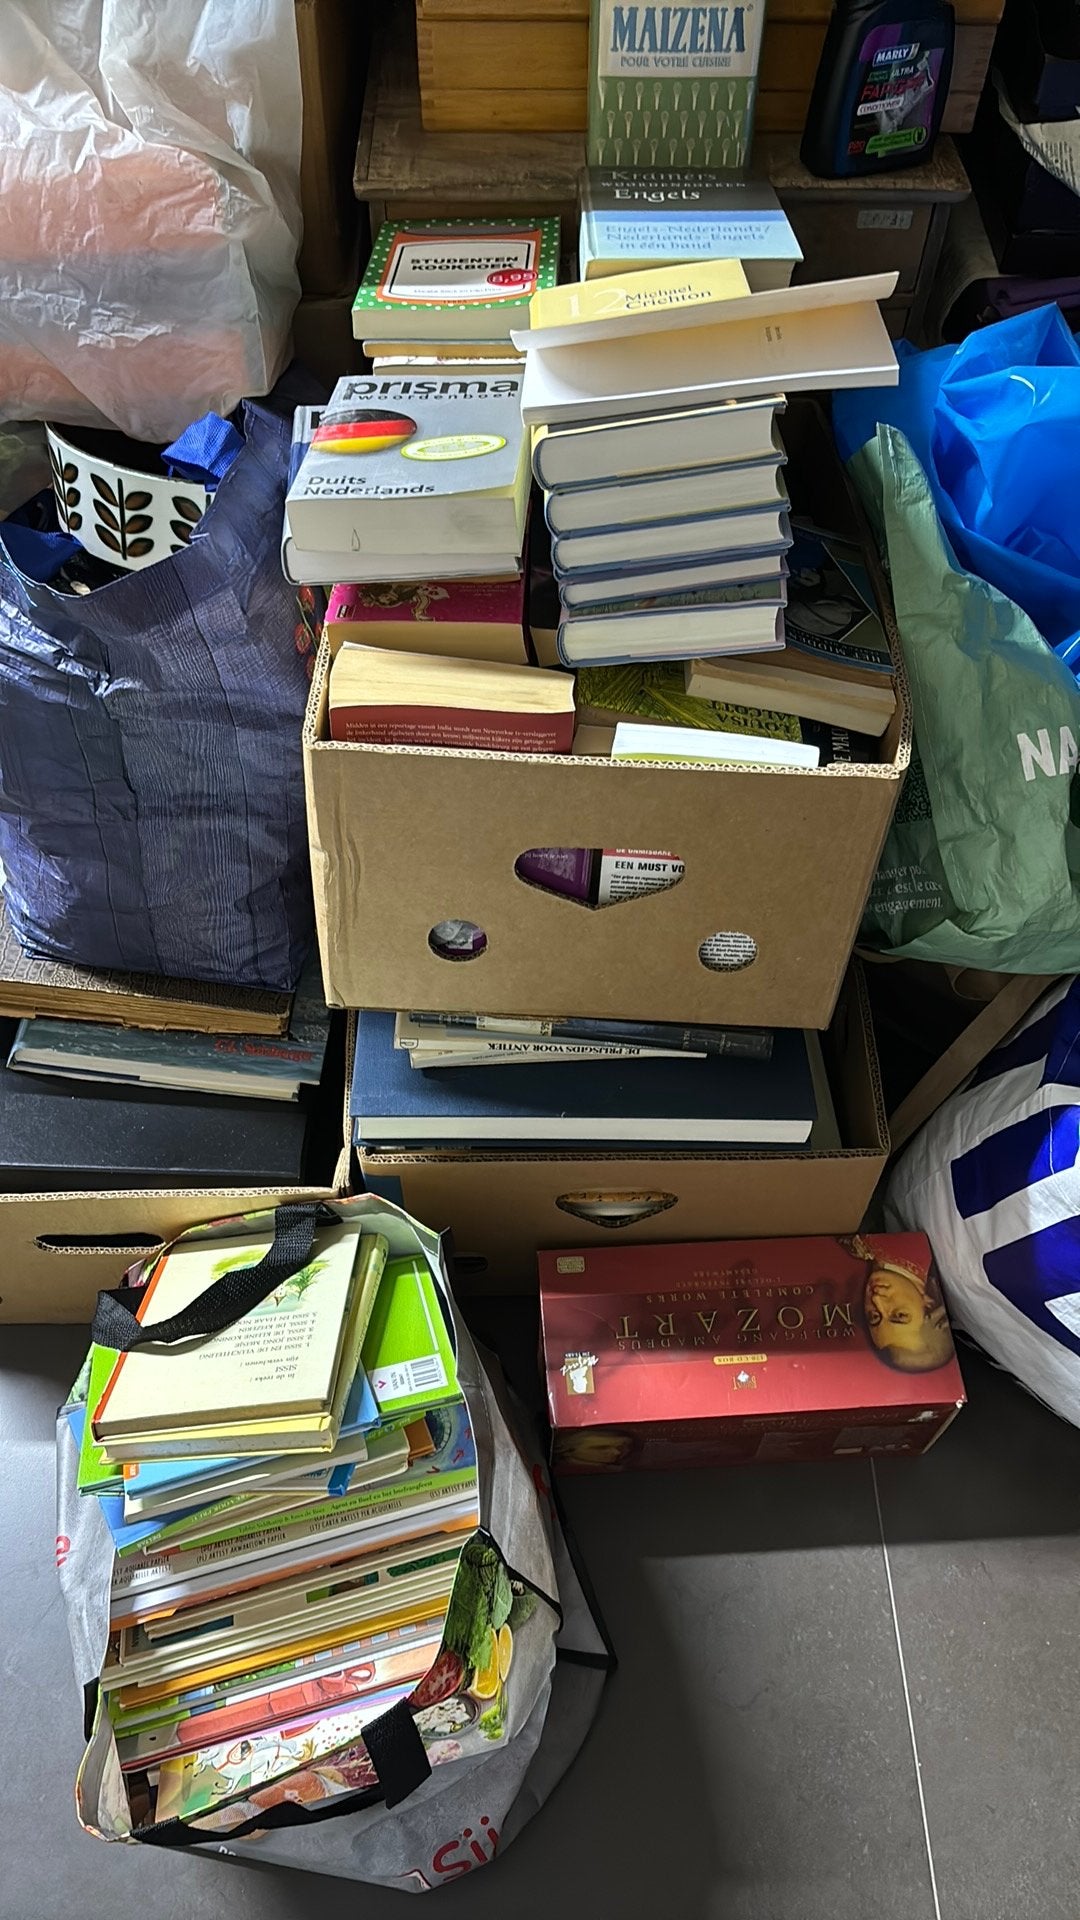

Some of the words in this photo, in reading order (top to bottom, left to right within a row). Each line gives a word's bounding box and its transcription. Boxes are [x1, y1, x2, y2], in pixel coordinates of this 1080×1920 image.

[611, 6, 746, 53] MAIZENA
[876, 48, 909, 62] MARLY
[620, 55, 649, 68] POUR
[654, 55, 689, 68] VOTRE
[692, 55, 731, 68] CUISINE
[612, 170, 717, 181] Kramers
[614, 188, 701, 203] Engels
[606, 233, 765, 241] Nederlands-Engels
[670, 241, 712, 249] band
[410, 256, 518, 264] STUDENTEN
[412, 263, 514, 271] KOOKBOEK
[492, 271, 533, 283] 8,95
[625, 284, 693, 301] Michael
[625, 290, 712, 310] Crichton
[343, 379, 519, 400] prisma
[357, 391, 517, 401] woordenboek
[308, 475, 367, 486] Duits
[303, 484, 436, 497] Nederlands
[615, 860, 634, 870] EEN
[638, 862, 668, 872] MUST
[487, 1042, 530, 1051] ANTIEK
[533, 1044, 564, 1053] VOOR
[565, 1045, 623, 1055] PRIJSGIDS
[625, 1047, 641, 1055] DE
[646, 1293, 707, 1303] WORKS
[720, 1285, 814, 1300] COMPLETE
[254, 1316, 277, 1324] HAAR
[292, 1312, 309, 1320] SISSI
[615, 1302, 854, 1339] MOZART
[286, 1335, 304, 1343] SISSI
[736, 1327, 856, 1344] WOLFGANG
[284, 1343, 302, 1351] SISSI
[618, 1335, 721, 1351] AMADEUS
[275, 1363, 298, 1373] SISSI
[331, 1501, 348, 1511] Agent
[340, 1514, 361, 1527] ARTIST
[207, 1548, 229, 1562] ARTIST
[267, 1534, 286, 1545] PAPIER
